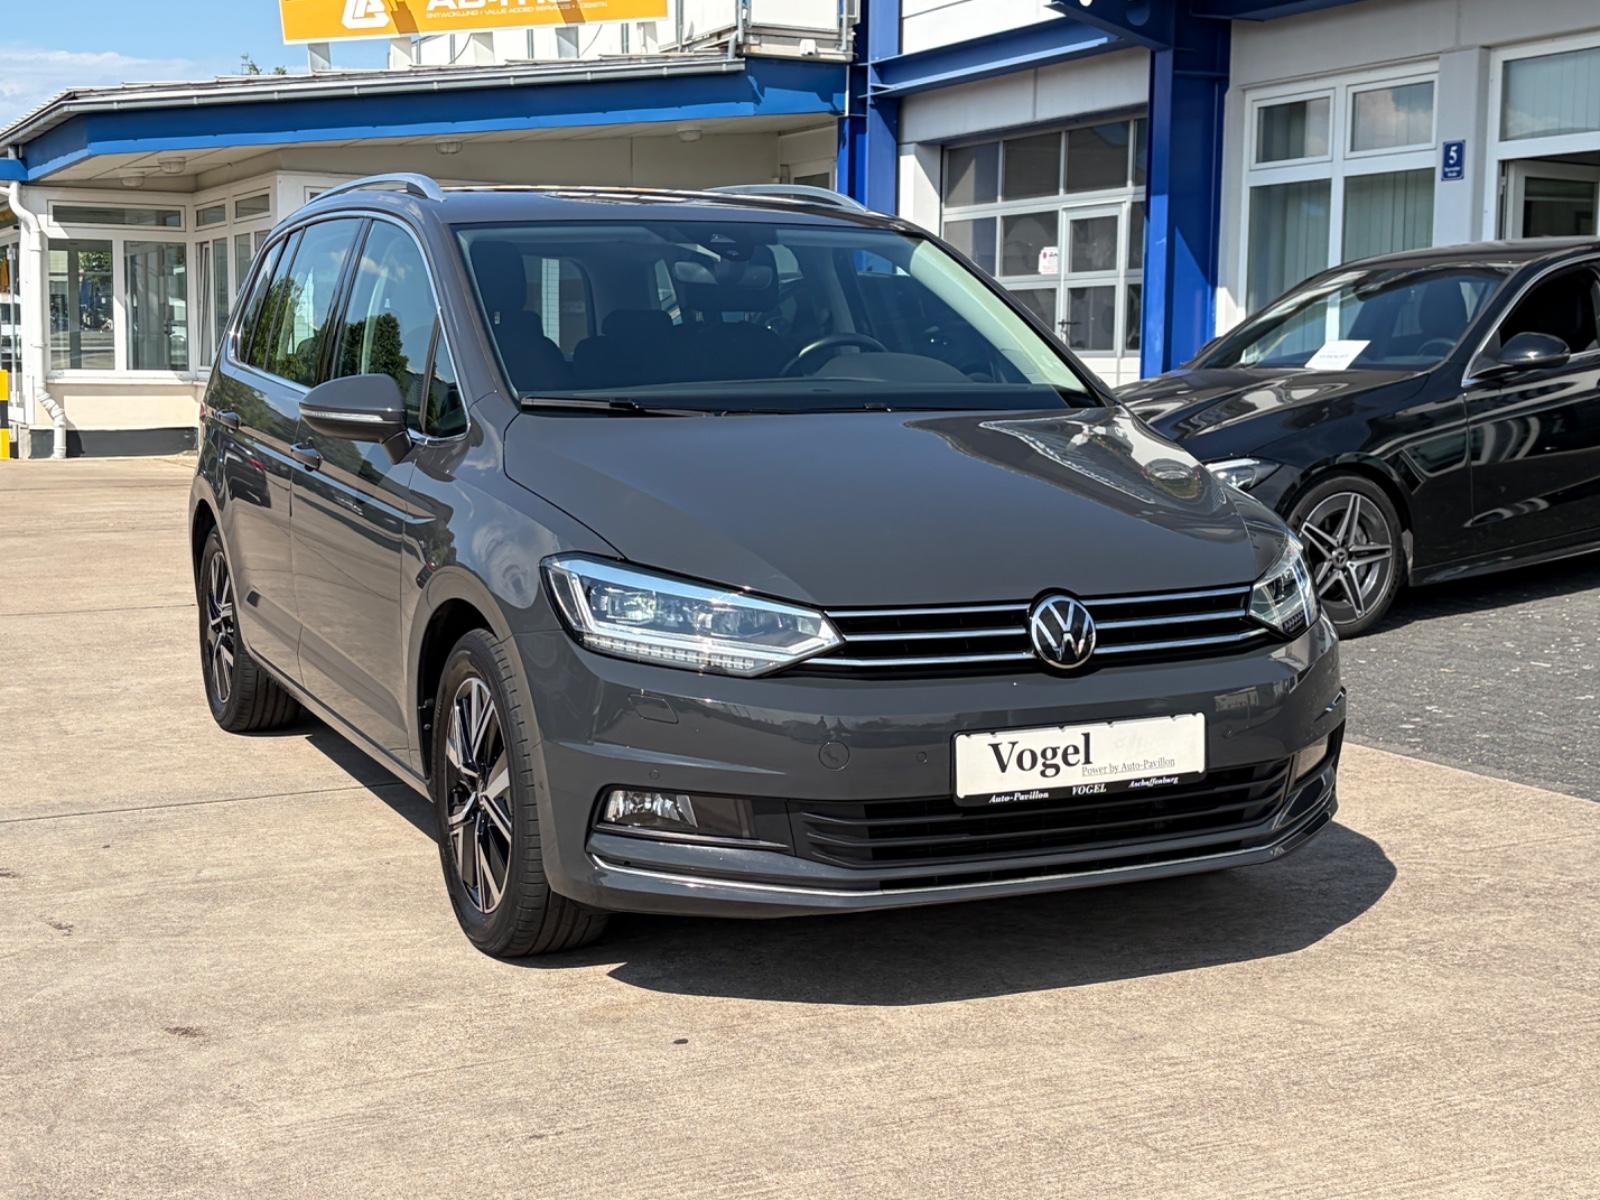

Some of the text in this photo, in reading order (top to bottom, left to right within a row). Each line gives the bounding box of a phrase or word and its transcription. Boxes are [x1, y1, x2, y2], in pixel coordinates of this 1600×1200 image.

[484, 7, 507, 16] VALUE
[509, 6, 533, 14] ADDED
[1449, 145, 1458, 164] 5
[988, 732, 1093, 778] Vogel
[1082, 757, 1175, 777] Power by Auto-Pavillon
[988, 776, 1179, 803] Auto-Pavillon VOGEL Aschaffenburg
